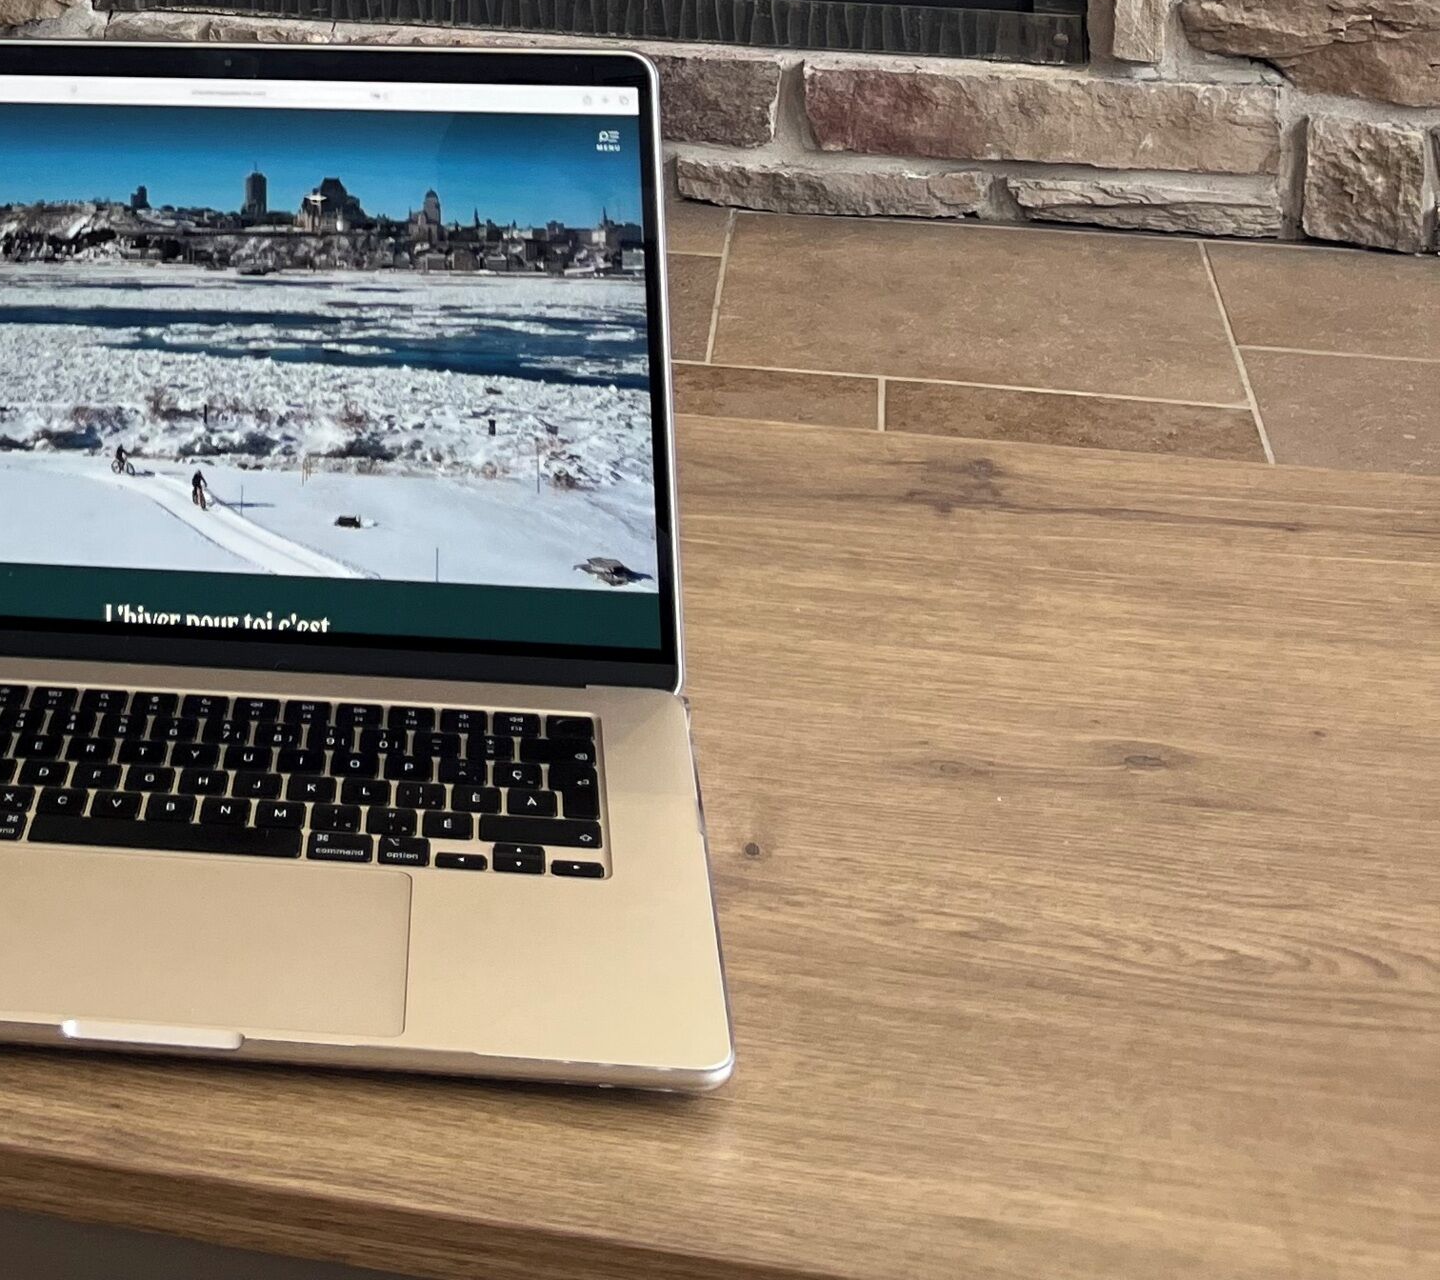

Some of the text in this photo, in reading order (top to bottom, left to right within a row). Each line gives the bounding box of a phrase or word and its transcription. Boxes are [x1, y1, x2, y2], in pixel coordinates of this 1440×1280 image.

[86, 744, 95, 752] R
[139, 747, 148, 756] T
[191, 750, 200, 758] Y
[243, 753, 253, 762] U
[350, 760, 360, 768] O
[404, 762, 413, 771] P
[38, 767, 50, 776] D
[198, 776, 209, 785] H
[252, 780, 261, 789] J
[307, 783, 317, 792] K
[362, 787, 370, 795] L
[4, 793, 14, 802] X
[58, 796, 68, 805] C
[112, 799, 122, 807] V
[220, 805, 231, 815] N
[274, 808, 287, 817] M
[316, 847, 364, 856] command
[386, 851, 419, 860] option
